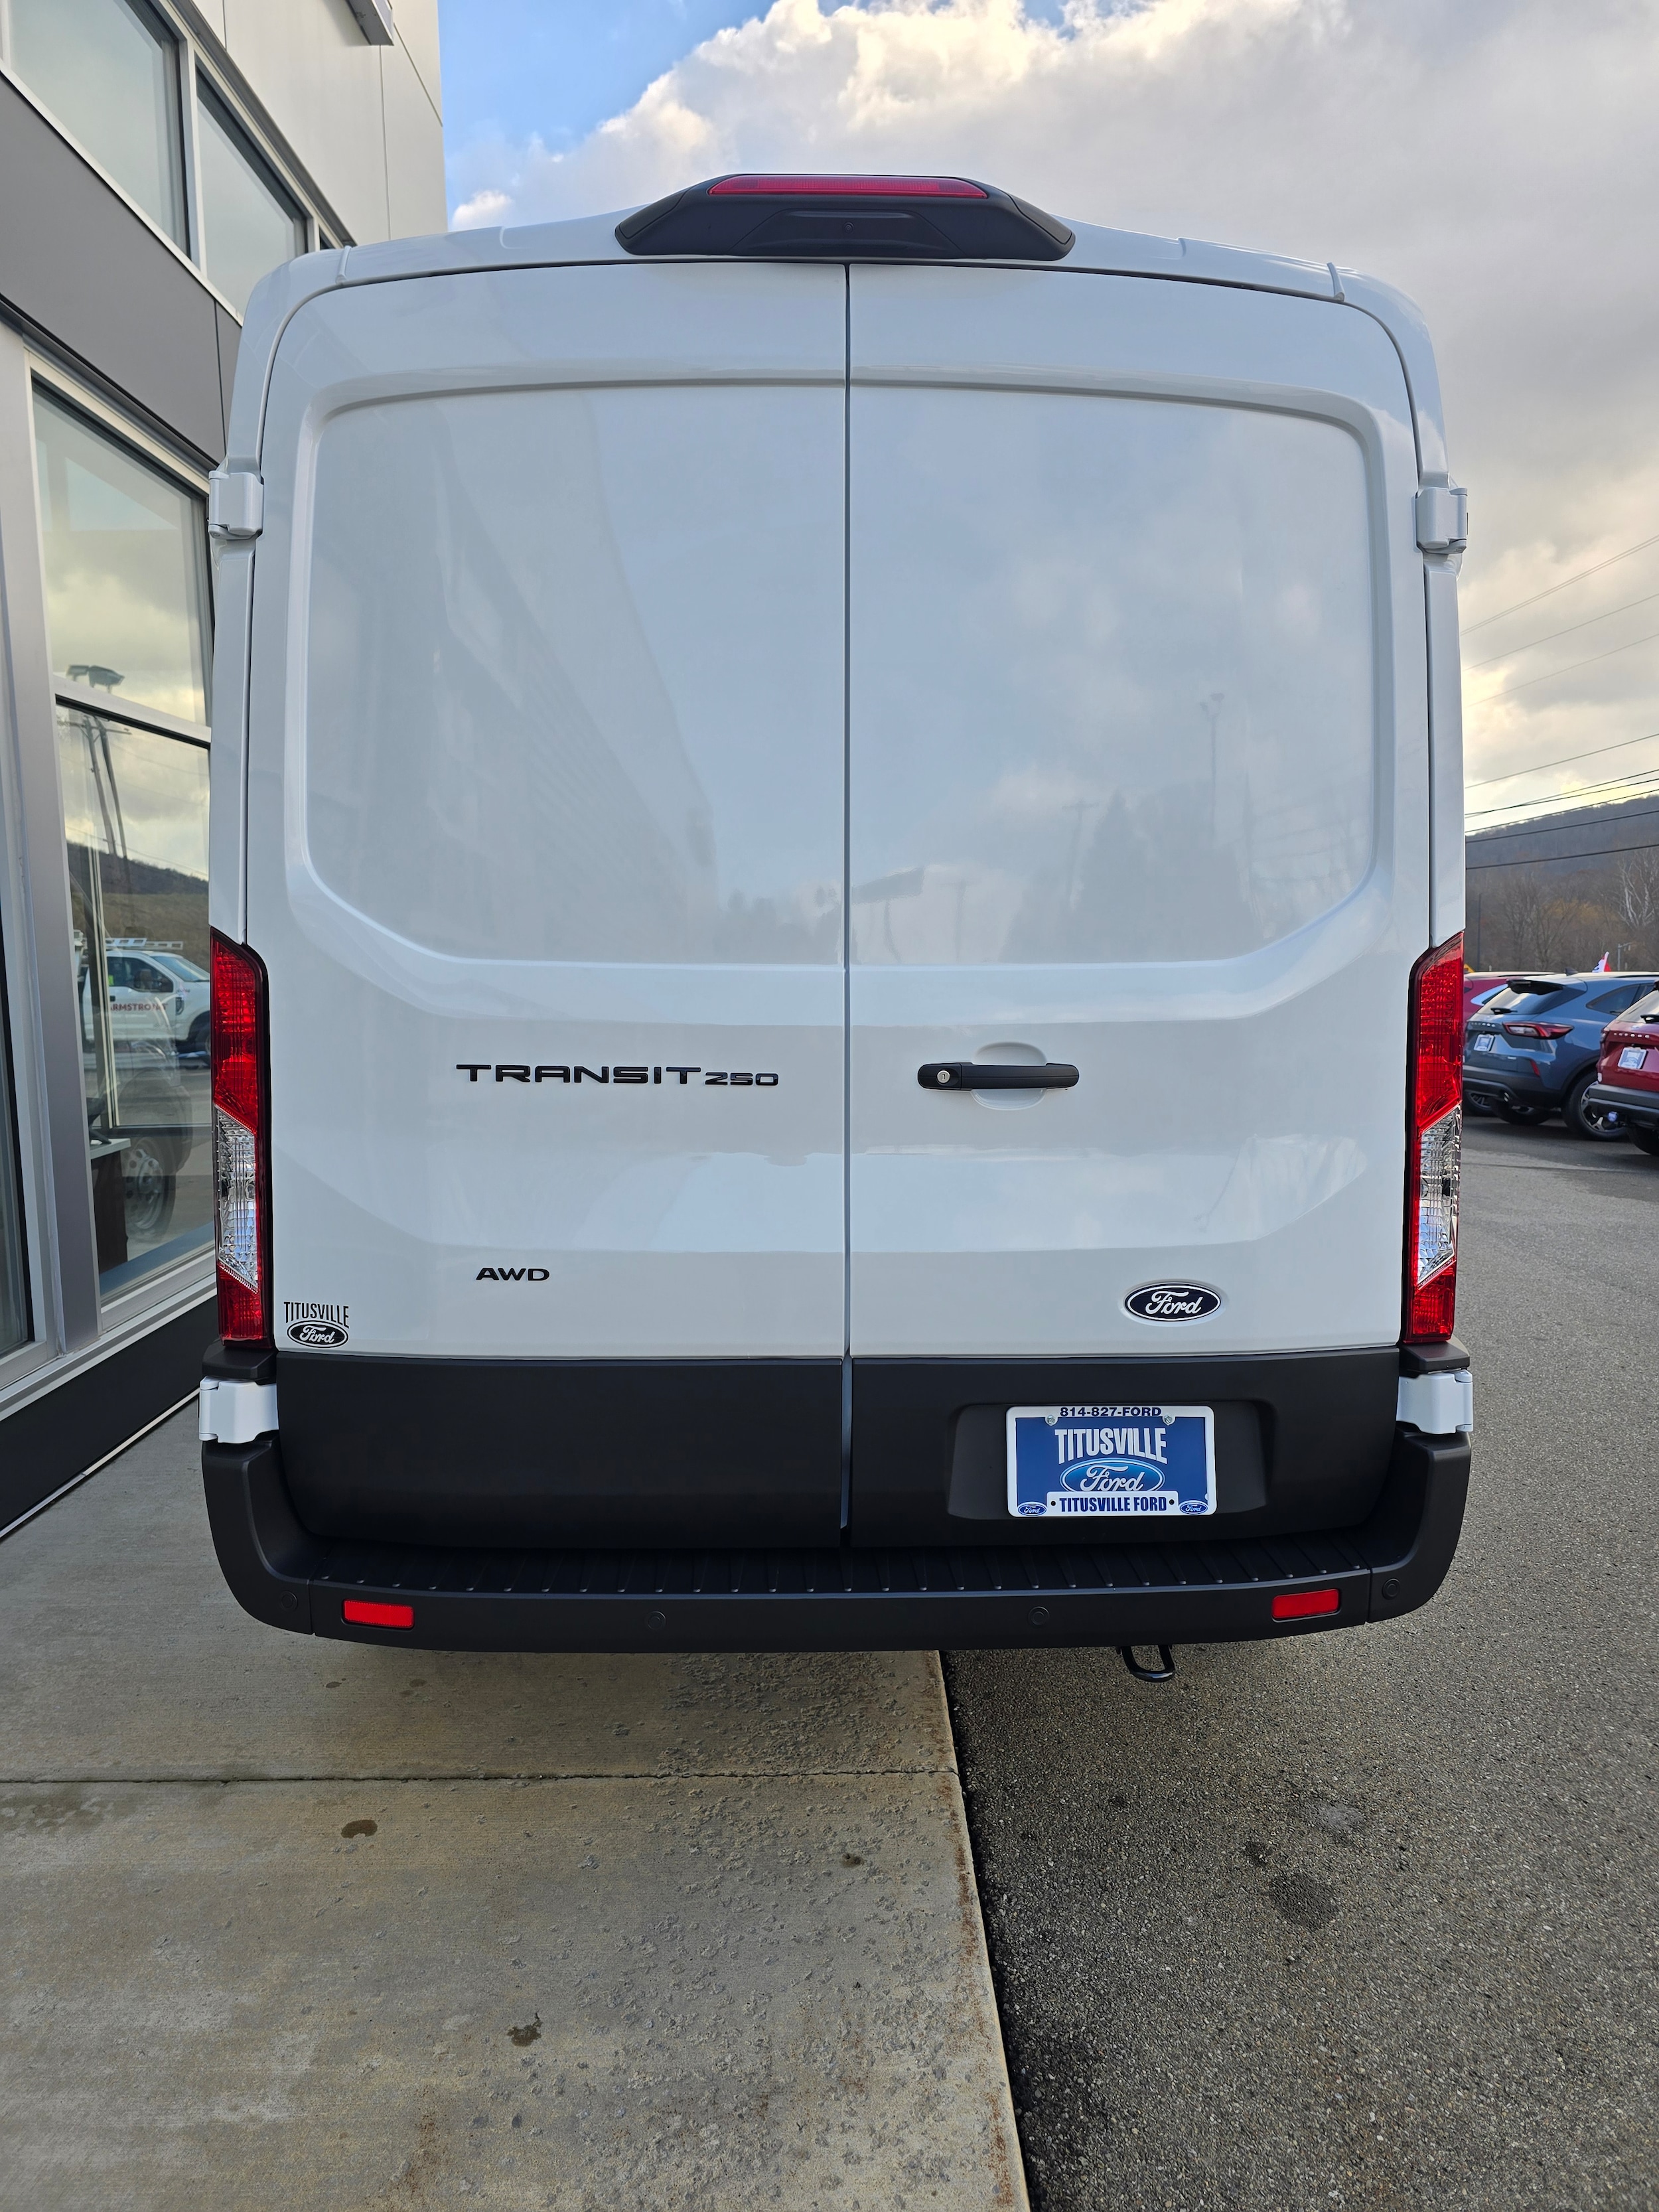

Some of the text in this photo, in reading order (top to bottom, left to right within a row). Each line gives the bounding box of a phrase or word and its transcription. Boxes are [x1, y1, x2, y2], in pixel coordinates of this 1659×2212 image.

[456, 1064, 779, 1086] TRANSIT 250
[475, 1267, 550, 1282] AWD
[1145, 1290, 1204, 1315] Ford
[283, 1301, 350, 1329] TITUSVILLE
[299, 1325, 336, 1343] Ford
[1059, 1406, 1162, 1417] 814-827-FORD
[1054, 1428, 1168, 1465] TITUSVILLE
[1080, 1465, 1145, 1491] Ford
[1023, 1505, 1041, 1514] Ford
[1059, 1497, 1167, 1512] TITUSVILLE FORD
